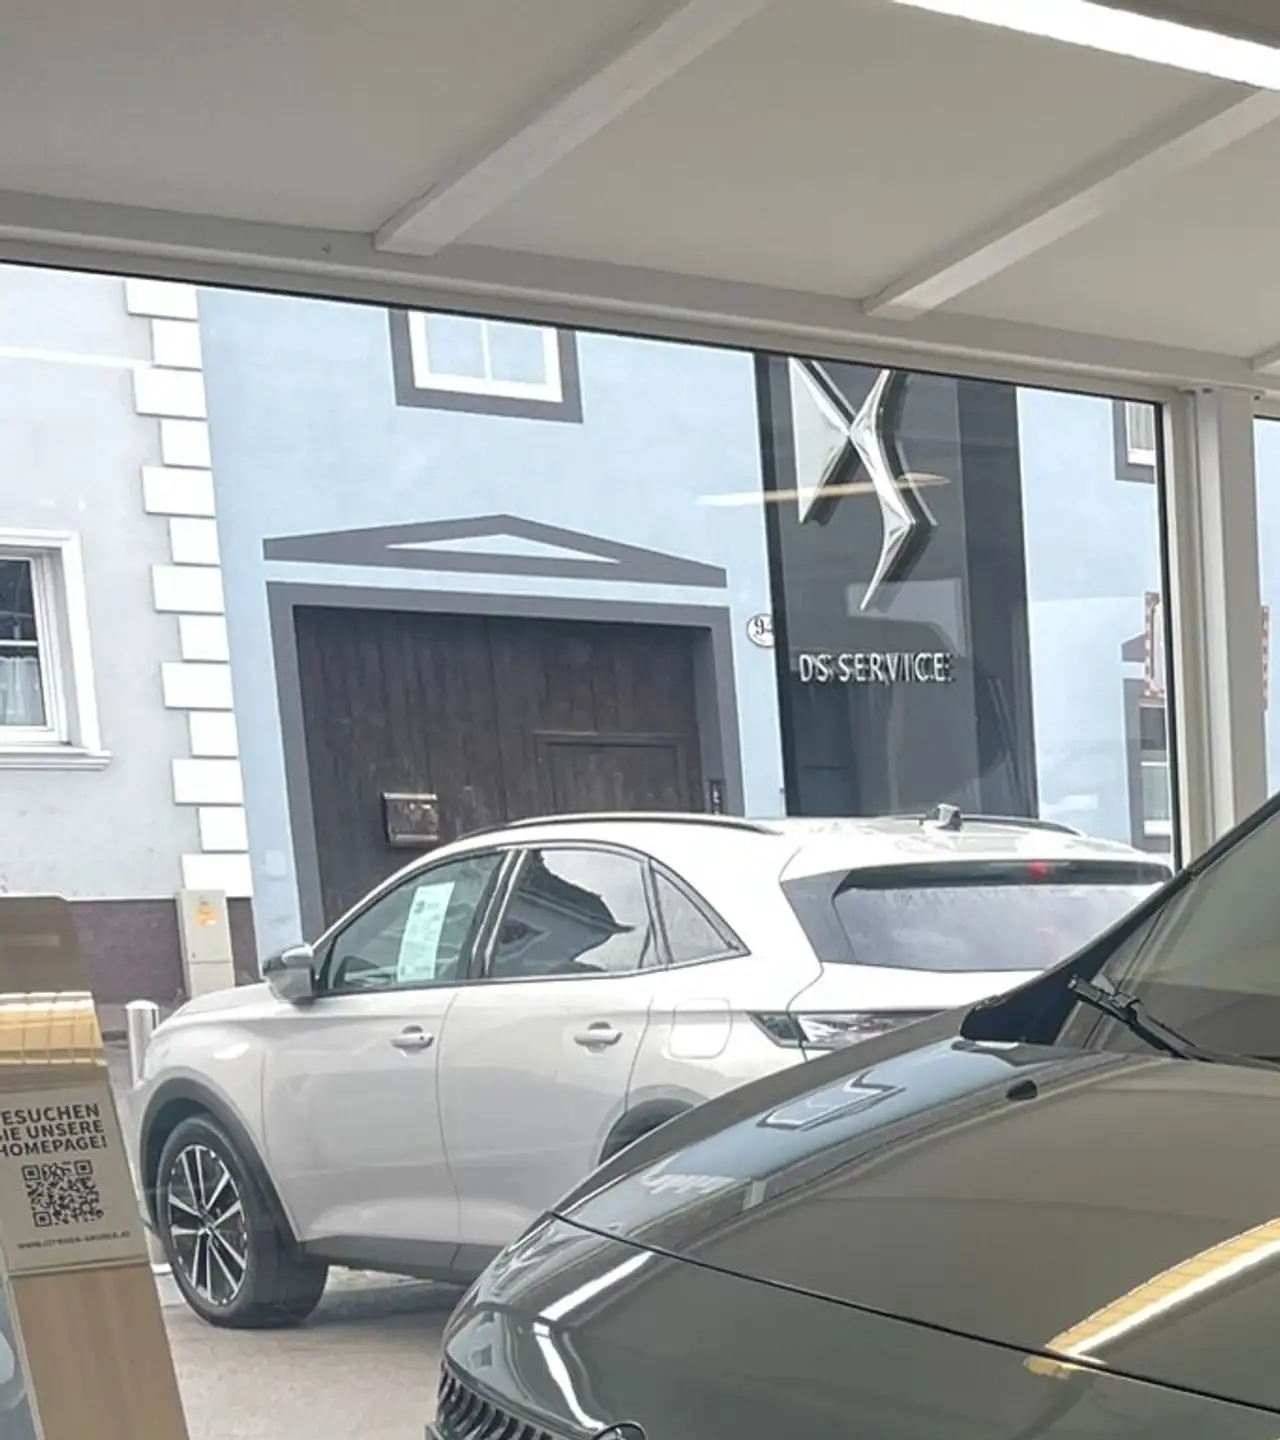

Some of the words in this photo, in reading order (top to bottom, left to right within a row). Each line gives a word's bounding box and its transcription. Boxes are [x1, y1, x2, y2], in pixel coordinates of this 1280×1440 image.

[799, 653, 831, 683] DS
[837, 652, 950, 683] SERVICE
[0, 1103, 100, 1126] ESUCHEN
[26, 1120, 105, 1139] UNSERE
